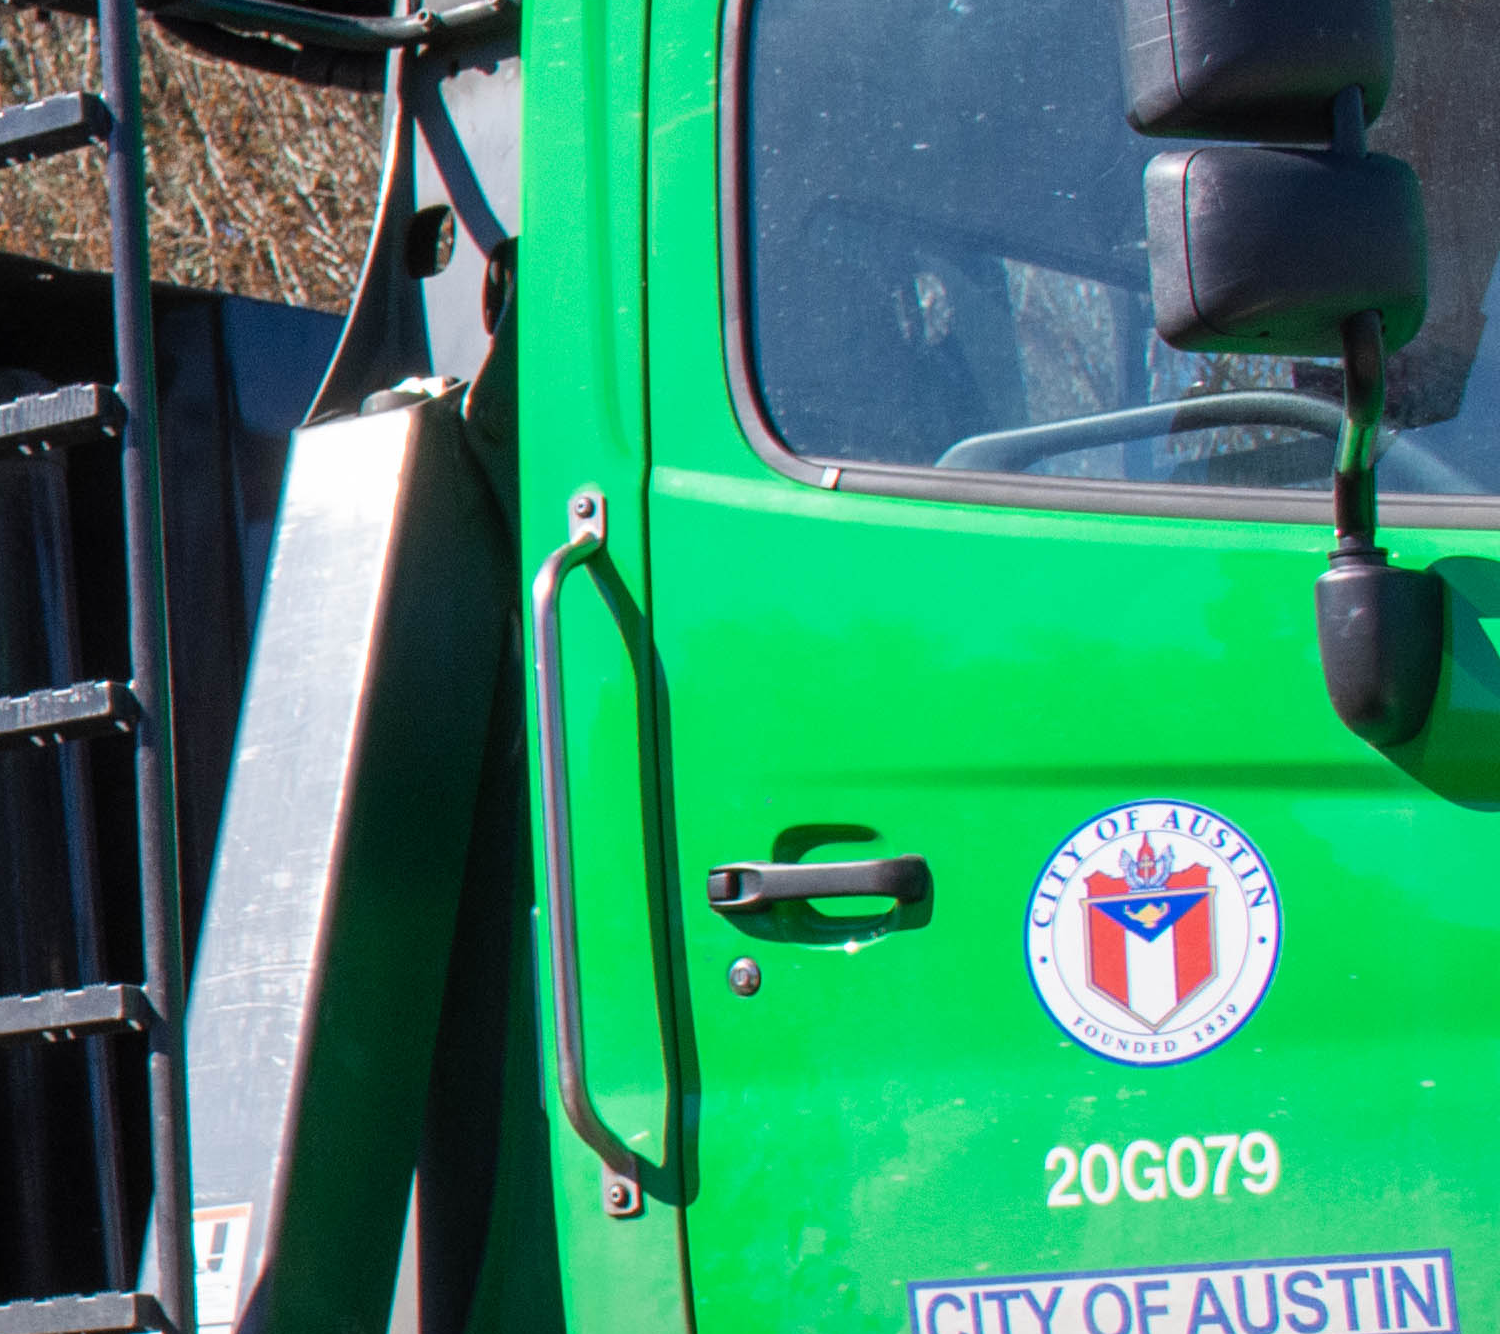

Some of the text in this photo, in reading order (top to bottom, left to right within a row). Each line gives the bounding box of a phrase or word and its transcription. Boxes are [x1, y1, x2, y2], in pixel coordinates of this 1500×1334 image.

[1031, 808, 1271, 929] CITY OF AUSTIN
[1072, 1003, 1238, 1054] FOUNDED 1839
[1044, 1130, 1280, 1207] 20G079
